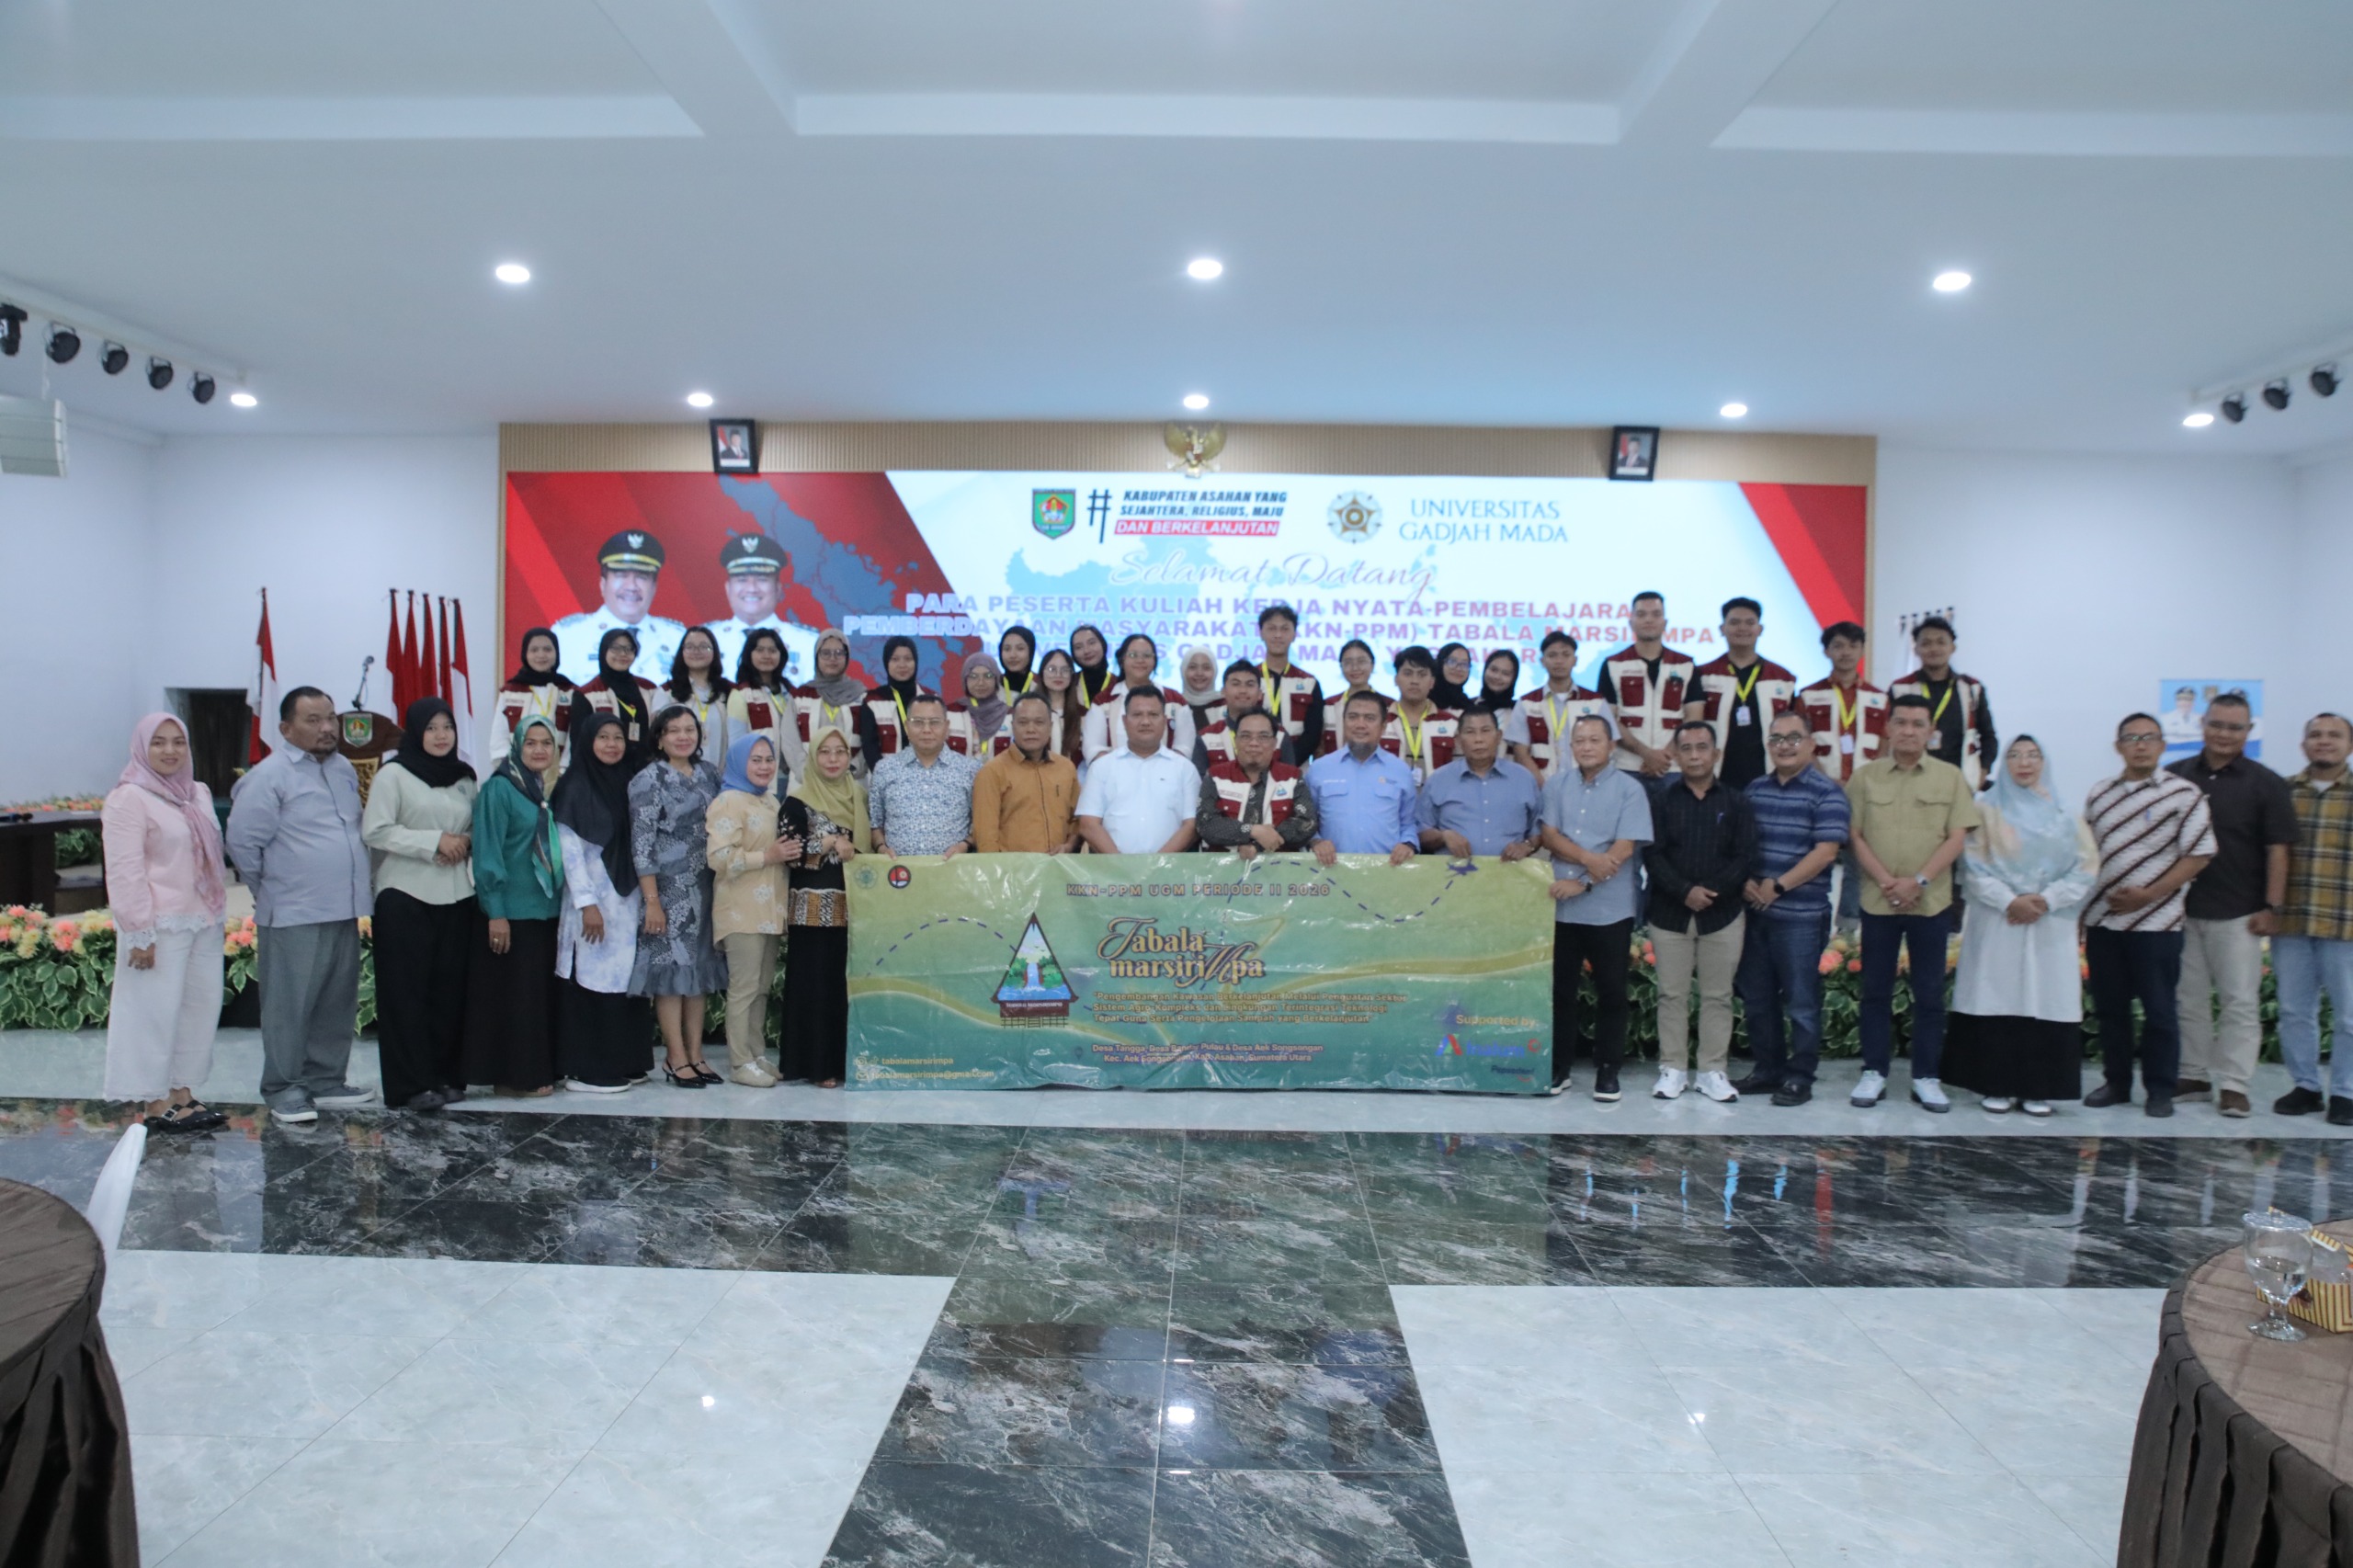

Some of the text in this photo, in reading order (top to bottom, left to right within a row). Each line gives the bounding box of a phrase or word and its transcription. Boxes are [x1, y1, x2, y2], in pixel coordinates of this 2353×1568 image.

[1123, 491, 1287, 503] KABUPATEN ASAHAN YANG
[1191, 506, 1249, 517] RELIGIUS,
[1252, 506, 1284, 517] MAJU
[1411, 499, 1560, 519] UNIVERSITAS
[1116, 520, 1278, 535] DAN BERKELANJUTAN
[1399, 522, 1568, 544] GADJAH MADA
[1110, 551, 1434, 603] Selamat Datang
[906, 593, 977, 613] PARA
[988, 596, 1110, 613] PESERTA
[1120, 597, 1222, 614] KULIAH
[1333, 599, 1632, 619] NYATA-PEMBELAJARA
[1076, 619, 1260, 638] ASYARAKAT
[1428, 624, 1533, 641] TABALA
[1066, 883, 1142, 897] KKN-PPM
[1149, 883, 1186, 897] UGM
[1192, 882, 1263, 896] PERIODE
[1269, 883, 1282, 896] II
[1097, 916, 1205, 960] Tabala
[1173, 993, 1214, 1001] Kawasan
[1322, 993, 1373, 1002] Penguatan
[1375, 994, 1407, 1002] Sektor
[1093, 1003, 1126, 1011] Sistem
[1281, 1004, 1338, 1012] Terintegrasi
[1341, 1004, 1388, 1013] Teknologi
[1094, 1015, 1120, 1023] Tepat
[1122, 1014, 1147, 1022] Guna
[1150, 1014, 1175, 1022] Serta
[1278, 1016, 1300, 1024] yang
[1456, 1014, 1518, 1026] Supported
[1092, 1044, 1113, 1052] Desa
[1200, 1042, 1223, 1051] Pulau
[881, 1057, 954, 1065] tabalamarsirimpa
[1289, 1053, 1313, 1062] Utara
